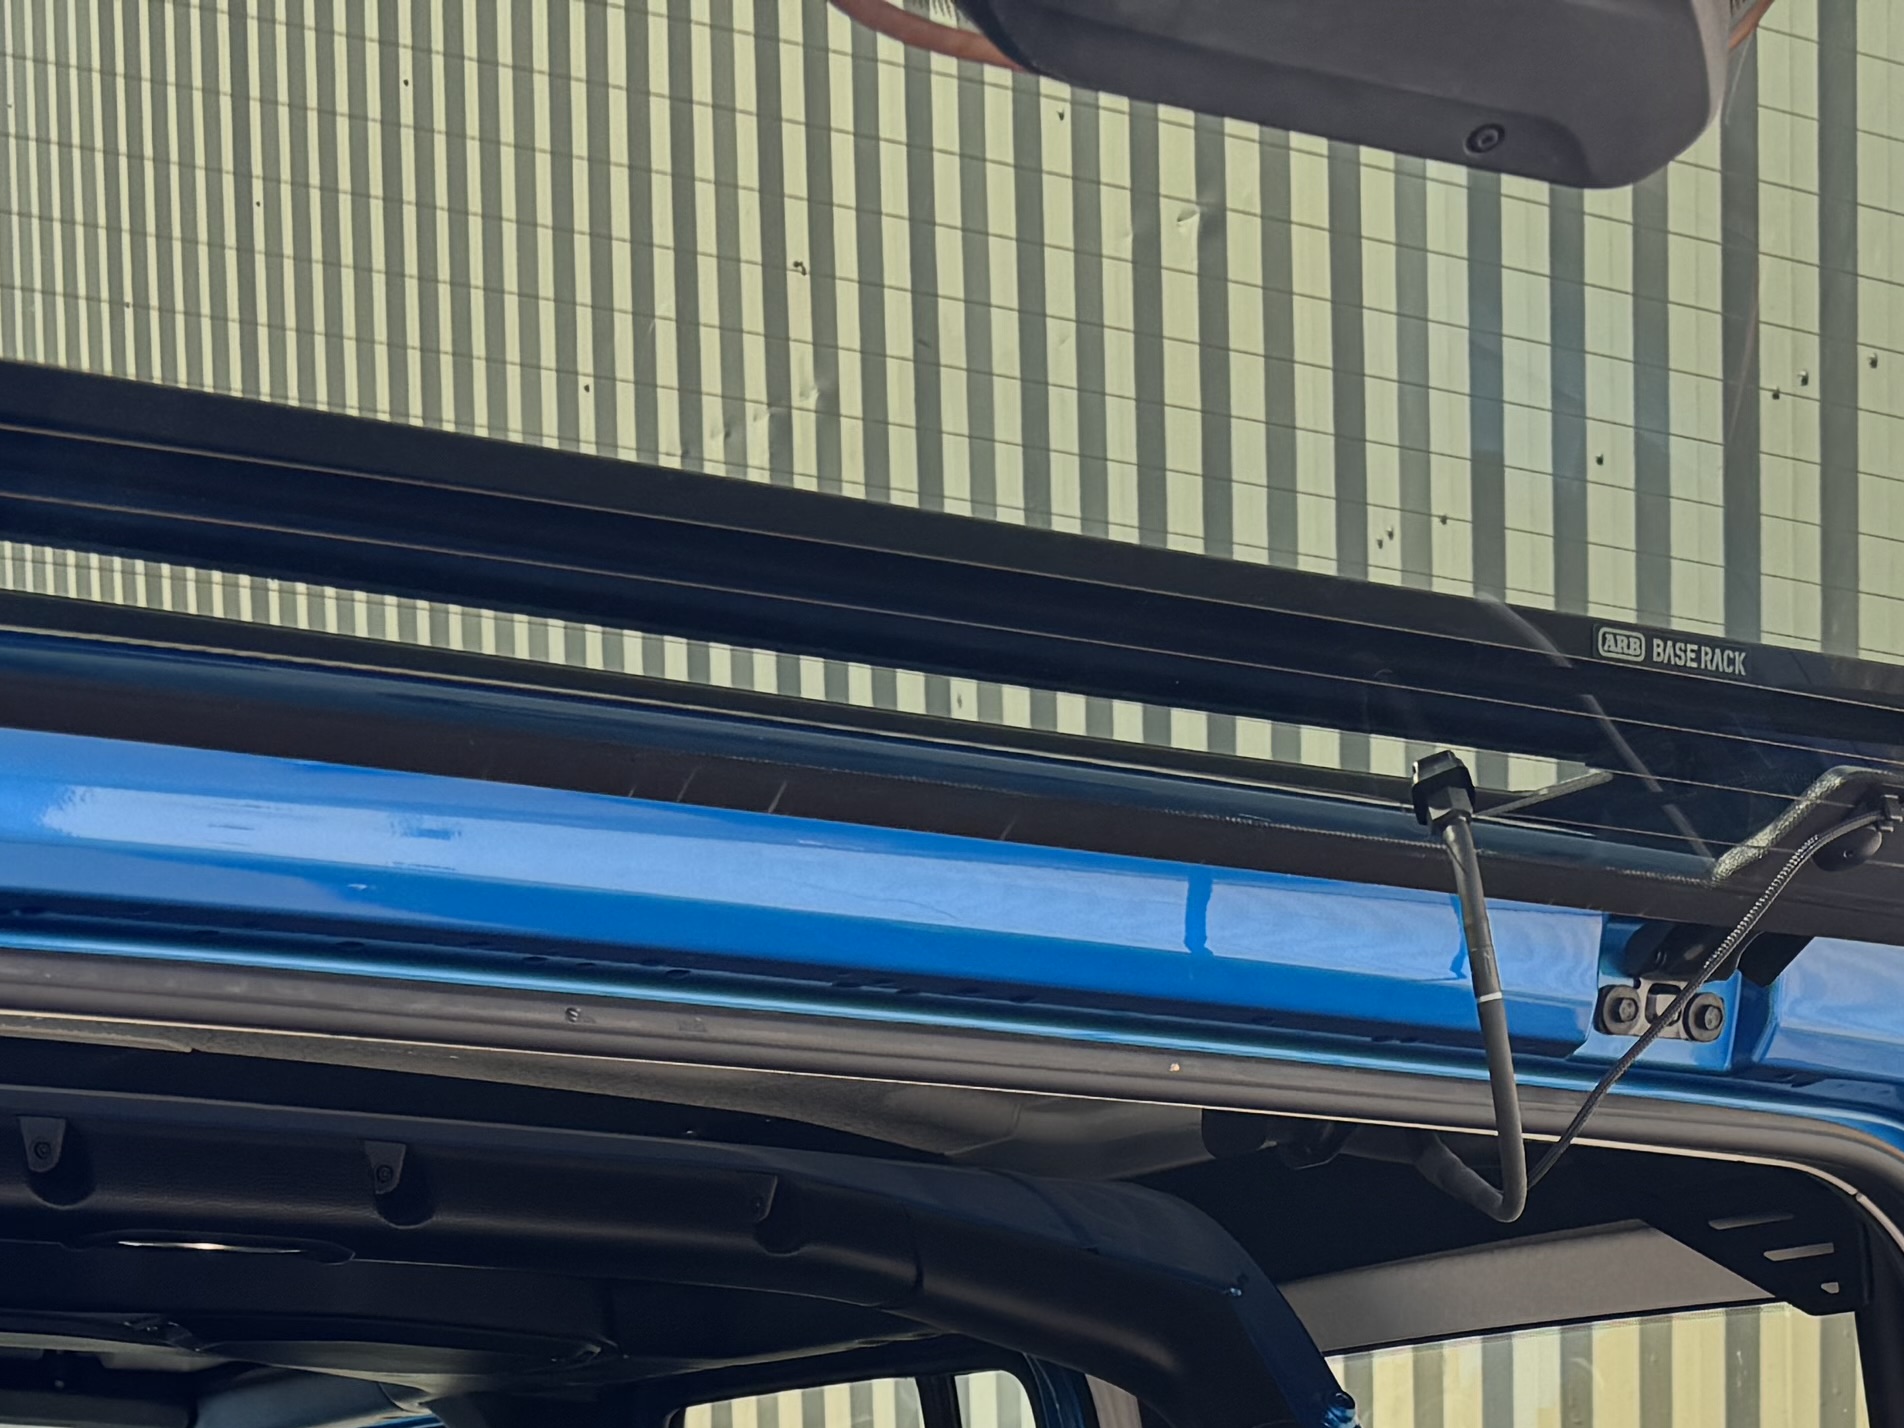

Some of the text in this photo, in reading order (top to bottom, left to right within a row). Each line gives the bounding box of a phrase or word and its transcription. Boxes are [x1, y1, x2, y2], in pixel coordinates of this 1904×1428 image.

[1603, 632, 1641, 657] ARB
[1652, 638, 1746, 676] BASE RACK
